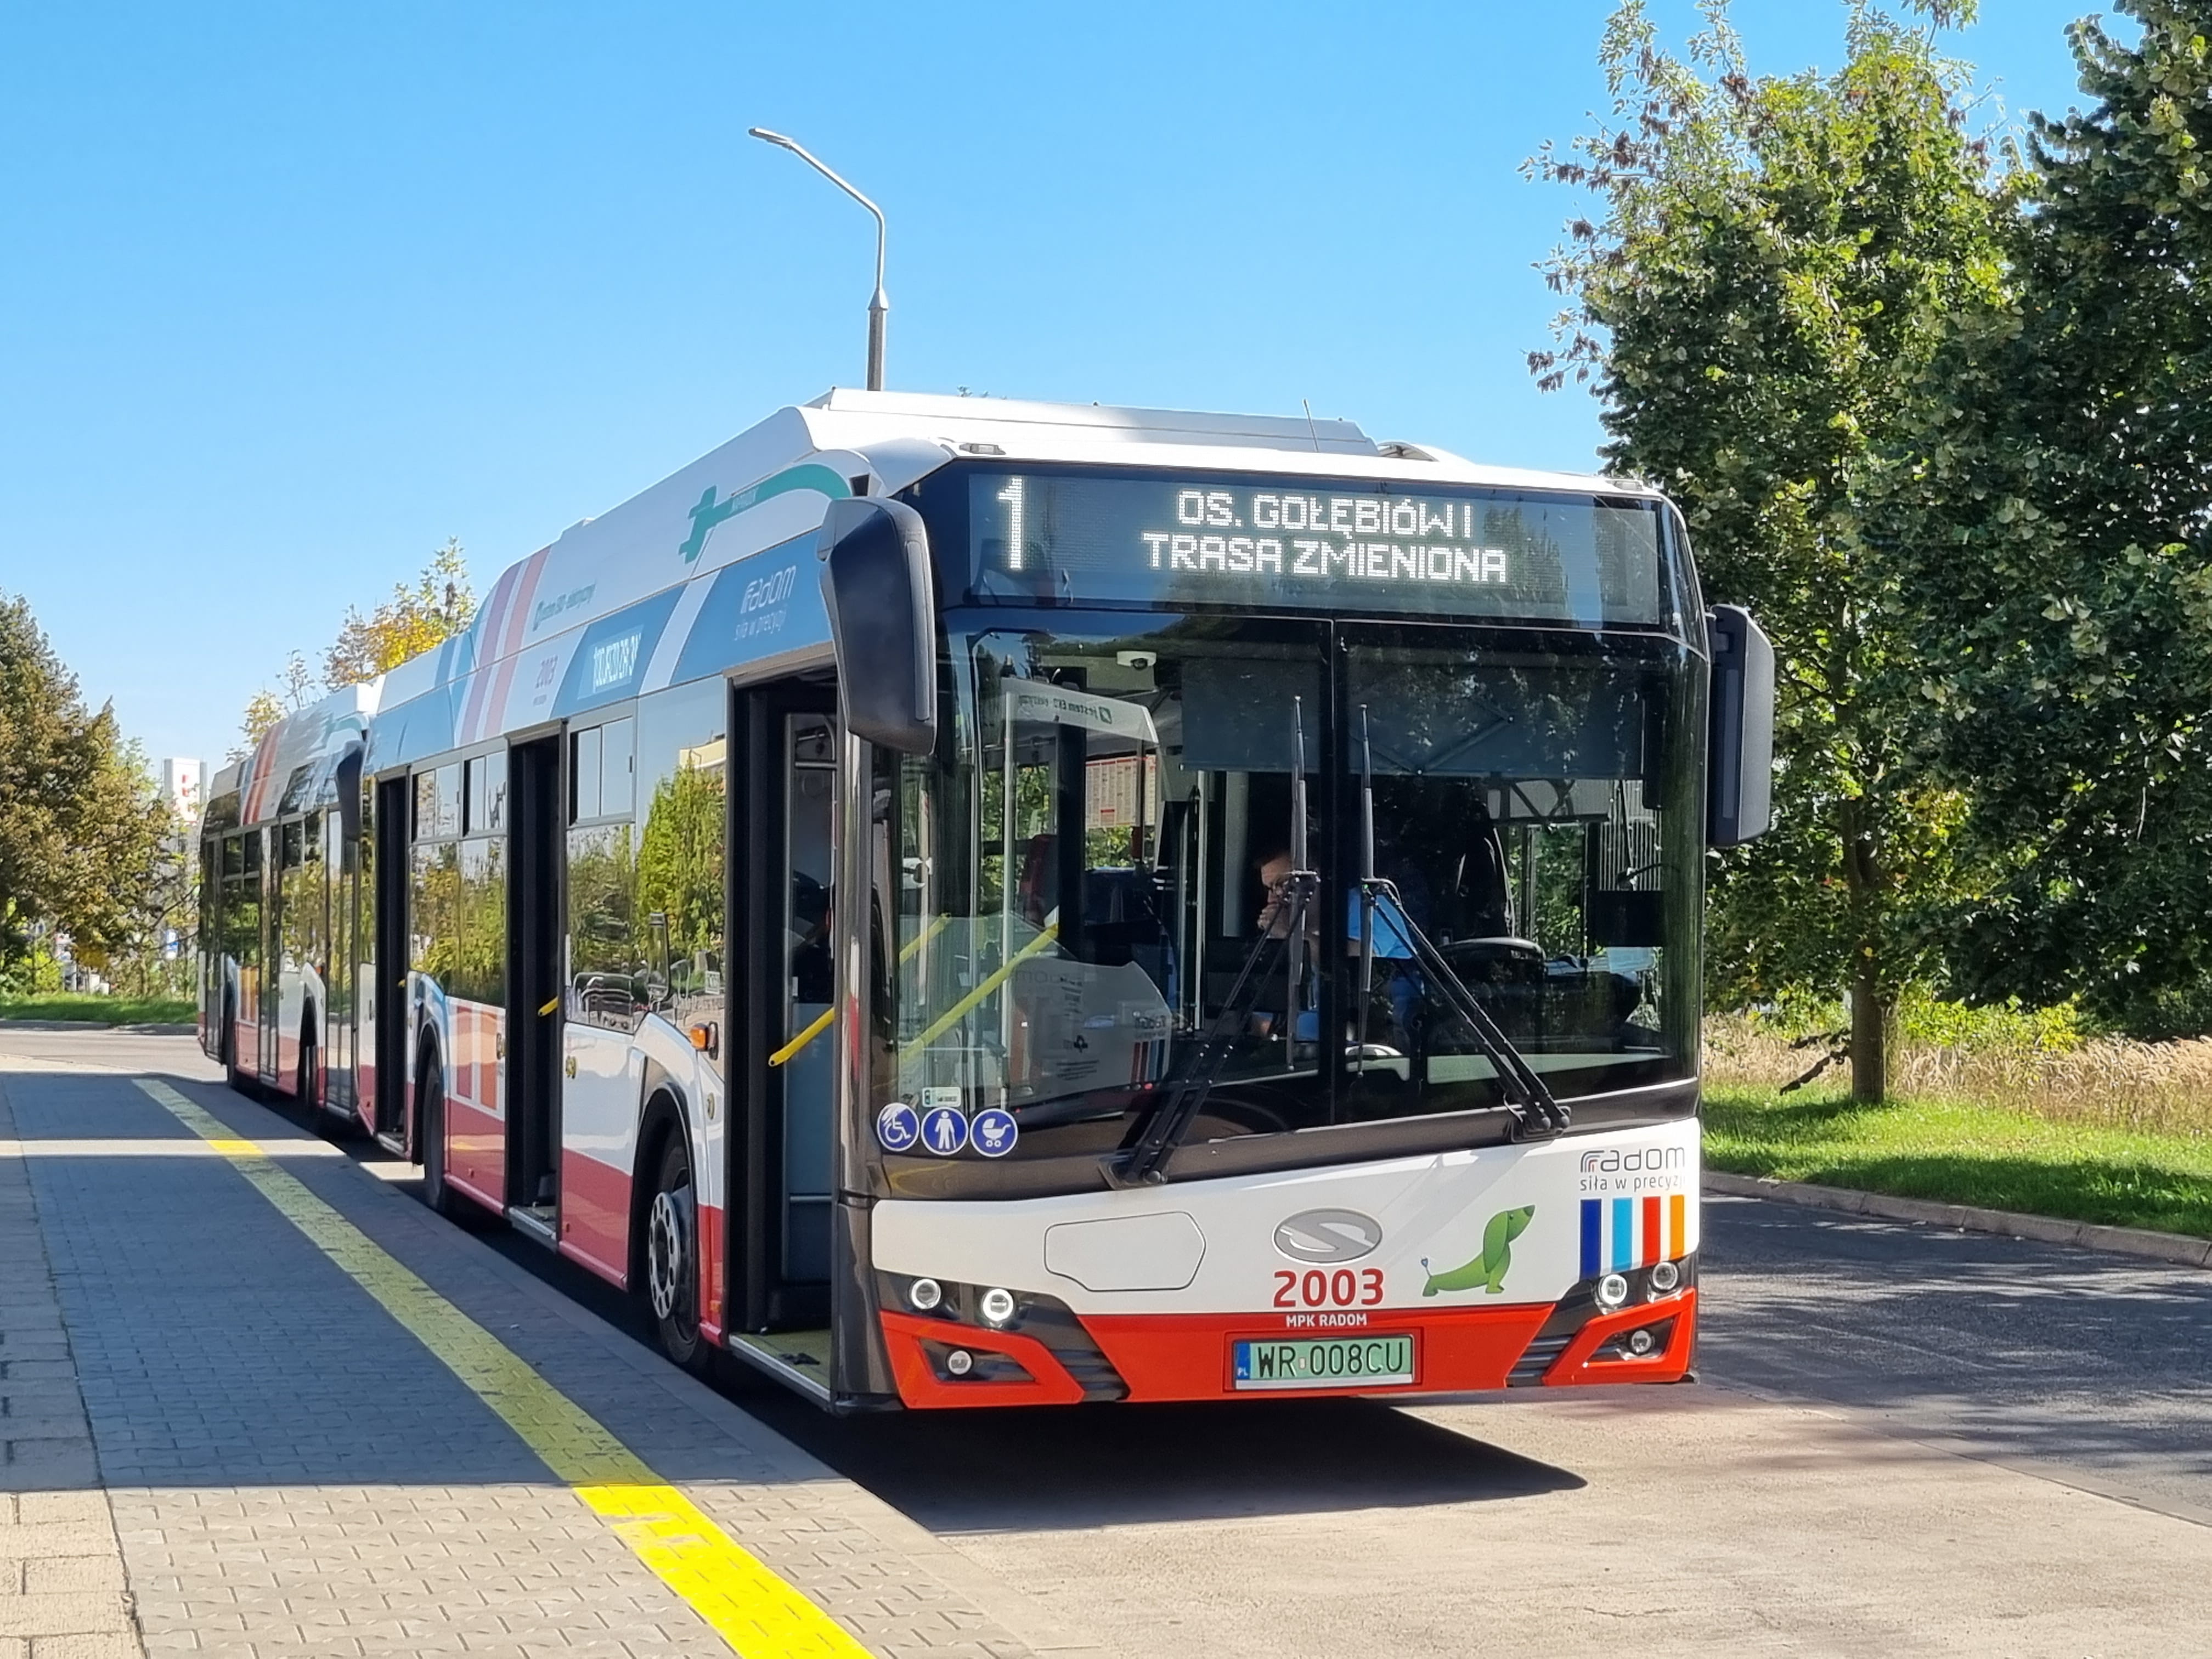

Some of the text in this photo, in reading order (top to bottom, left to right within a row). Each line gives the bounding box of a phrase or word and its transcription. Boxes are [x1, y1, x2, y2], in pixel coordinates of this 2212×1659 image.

[998, 477, 1023, 569] 1
[1178, 490, 1471, 540] OS. GOŁĘBIÓW I
[1143, 533, 1506, 583] TRASA ZMIENIONA
[740, 565, 797, 614] radom
[1580, 1147, 1685, 1173] radom
[1580, 1175, 1608, 1191] siła
[1615, 1178, 1627, 1190] w
[1273, 1268, 1385, 1308] 2003
[1285, 1313, 1368, 1327] MPK RADOM
[1237, 1367, 1249, 1376] PL
[1257, 1341, 1403, 1378] WR 008CU
